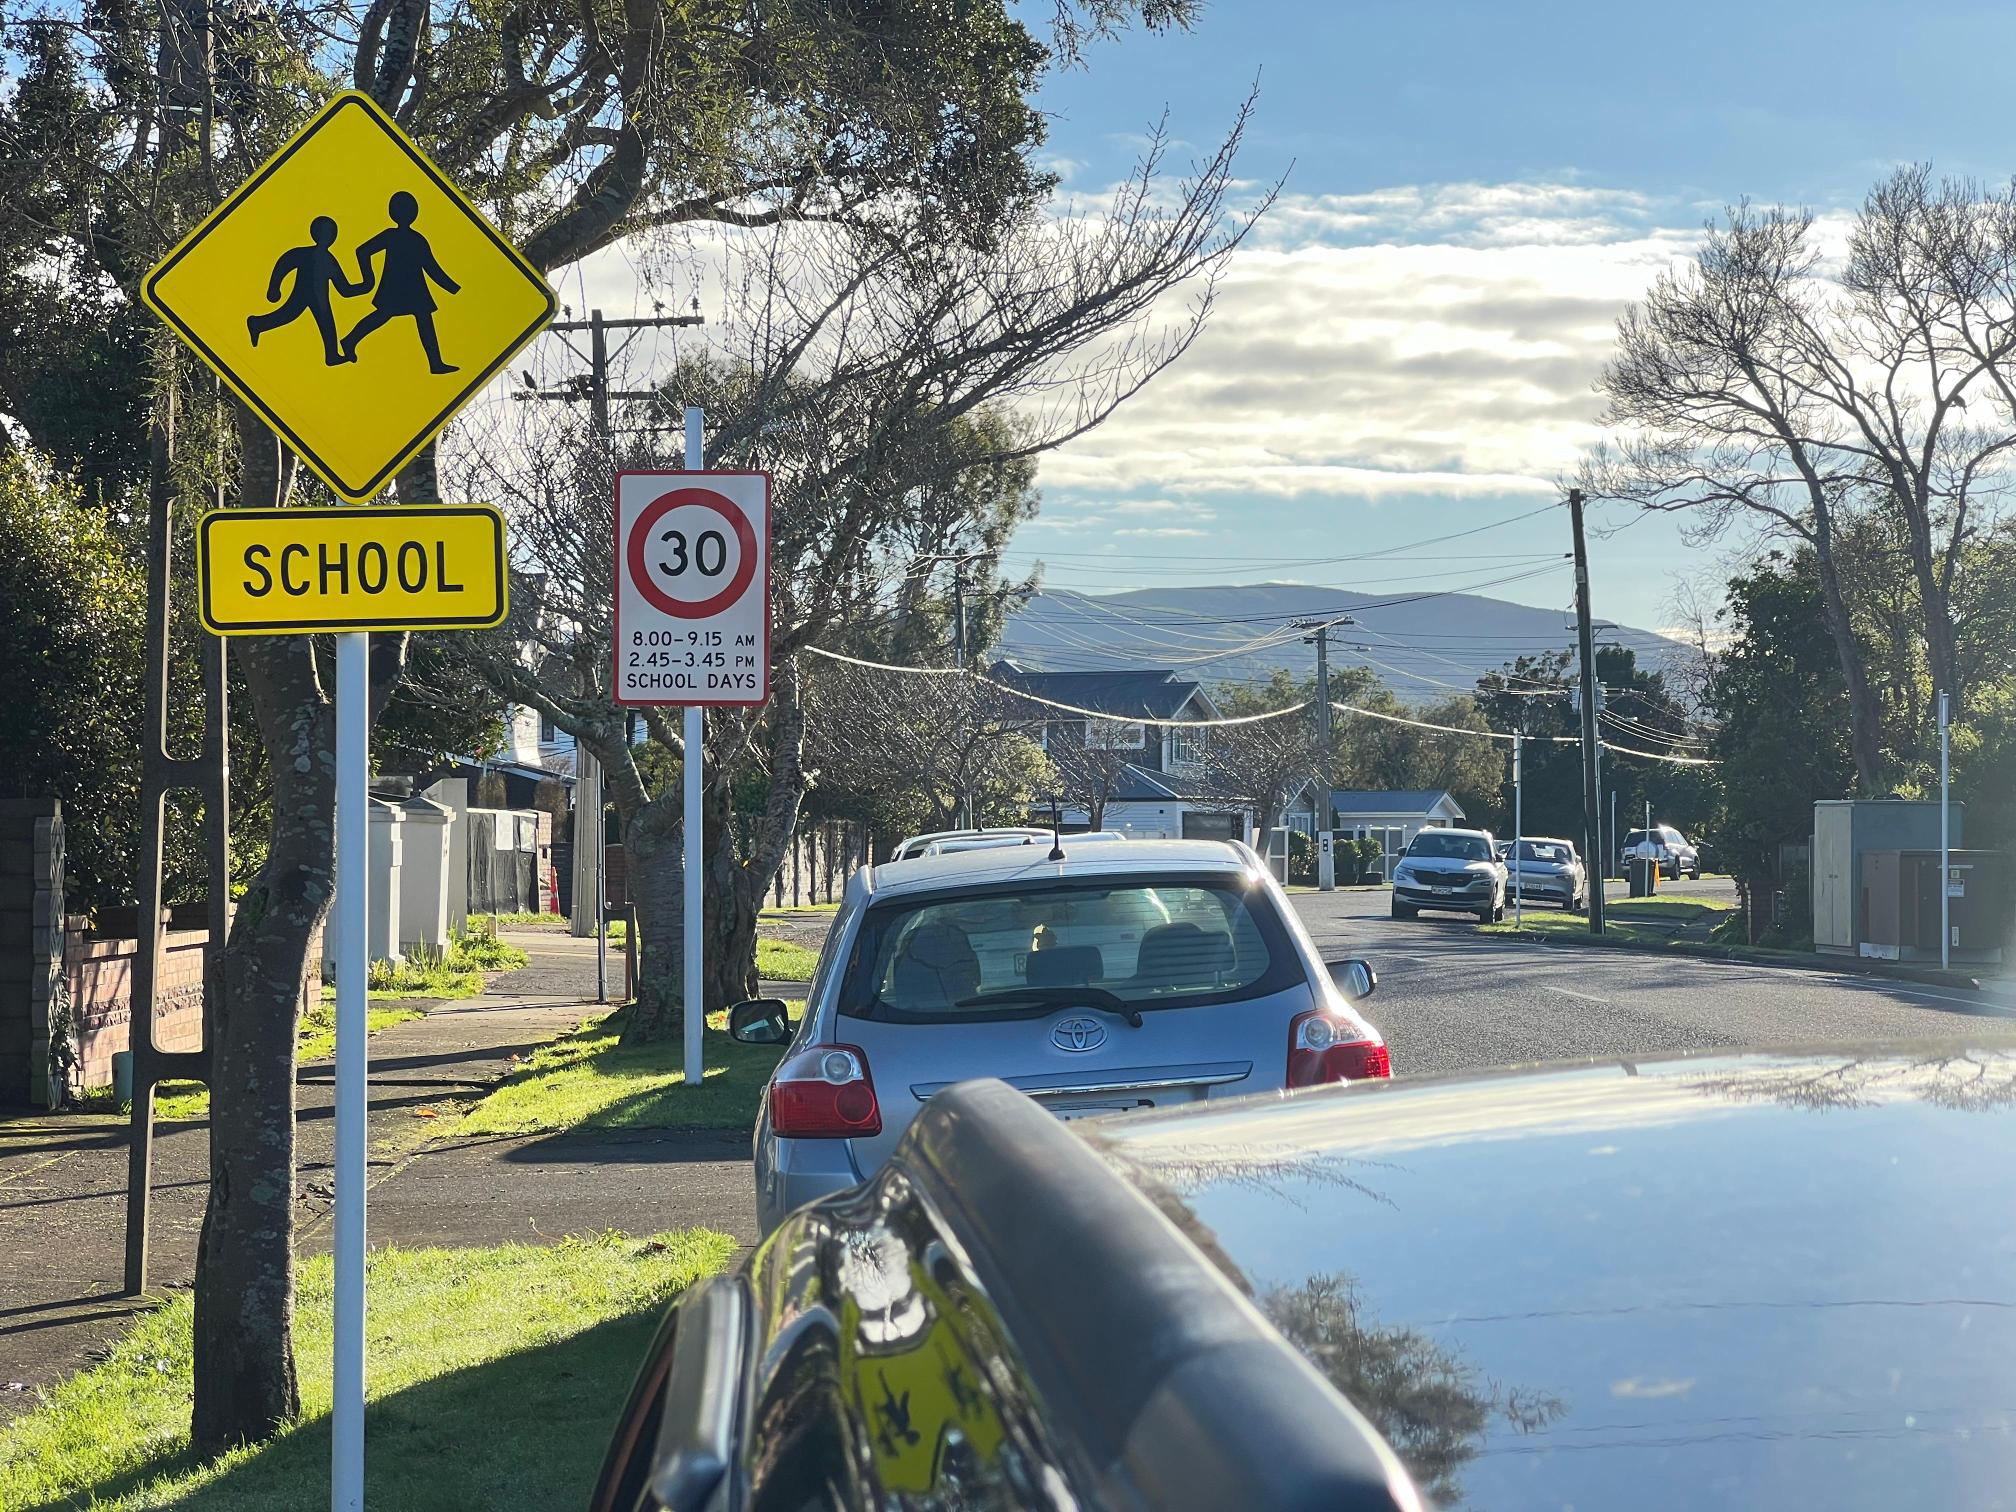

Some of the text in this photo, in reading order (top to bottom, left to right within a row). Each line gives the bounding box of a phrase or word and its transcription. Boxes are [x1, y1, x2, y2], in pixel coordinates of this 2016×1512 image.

[658, 530, 727, 577] 30
[243, 540, 464, 597] SCHOOL
[734, 634, 755, 647] AM
[735, 655, 755, 668] PM
[626, 672, 756, 689] SCHOOL DAYS
